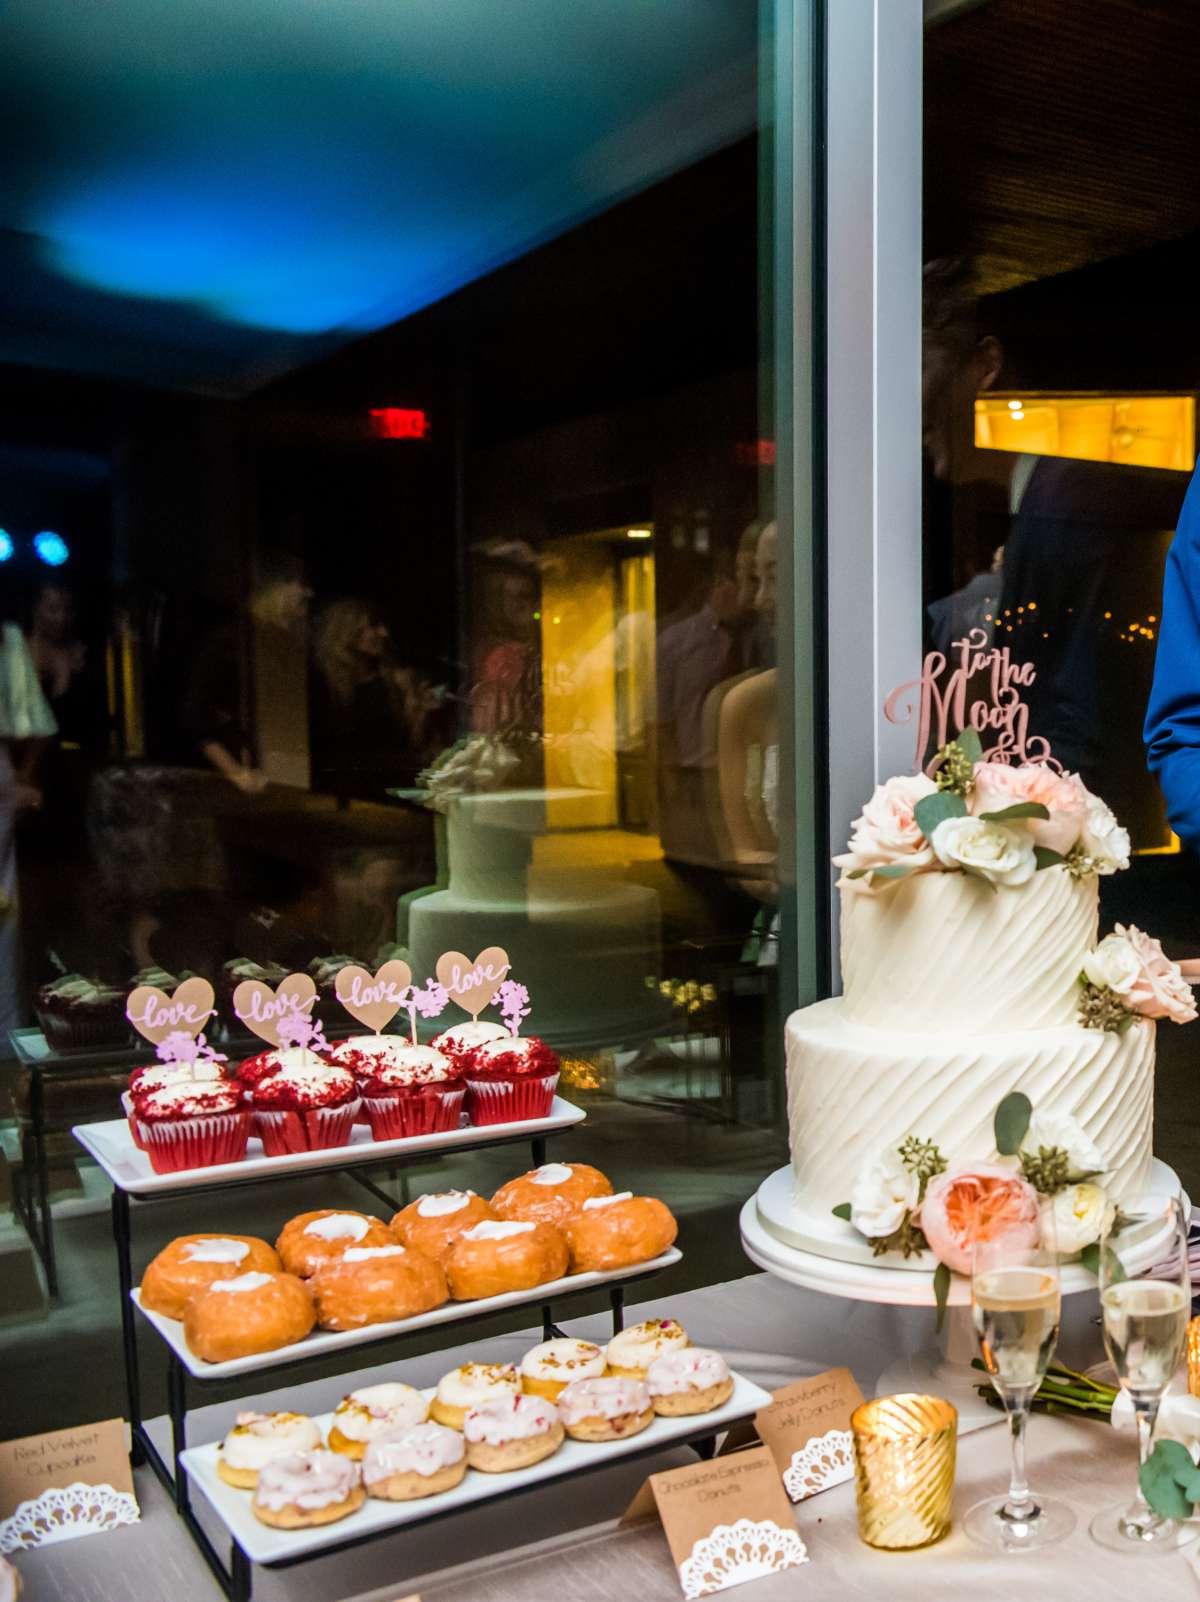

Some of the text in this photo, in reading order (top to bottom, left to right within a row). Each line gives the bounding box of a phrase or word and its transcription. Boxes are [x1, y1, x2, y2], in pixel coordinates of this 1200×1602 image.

[883, 651, 1029, 768] Moon
[336, 976, 415, 1007] love
[433, 963, 512, 994] love
[126, 995, 218, 1028] love
[235, 991, 320, 1022] love
[47, 1432, 99, 1451] Velvet
